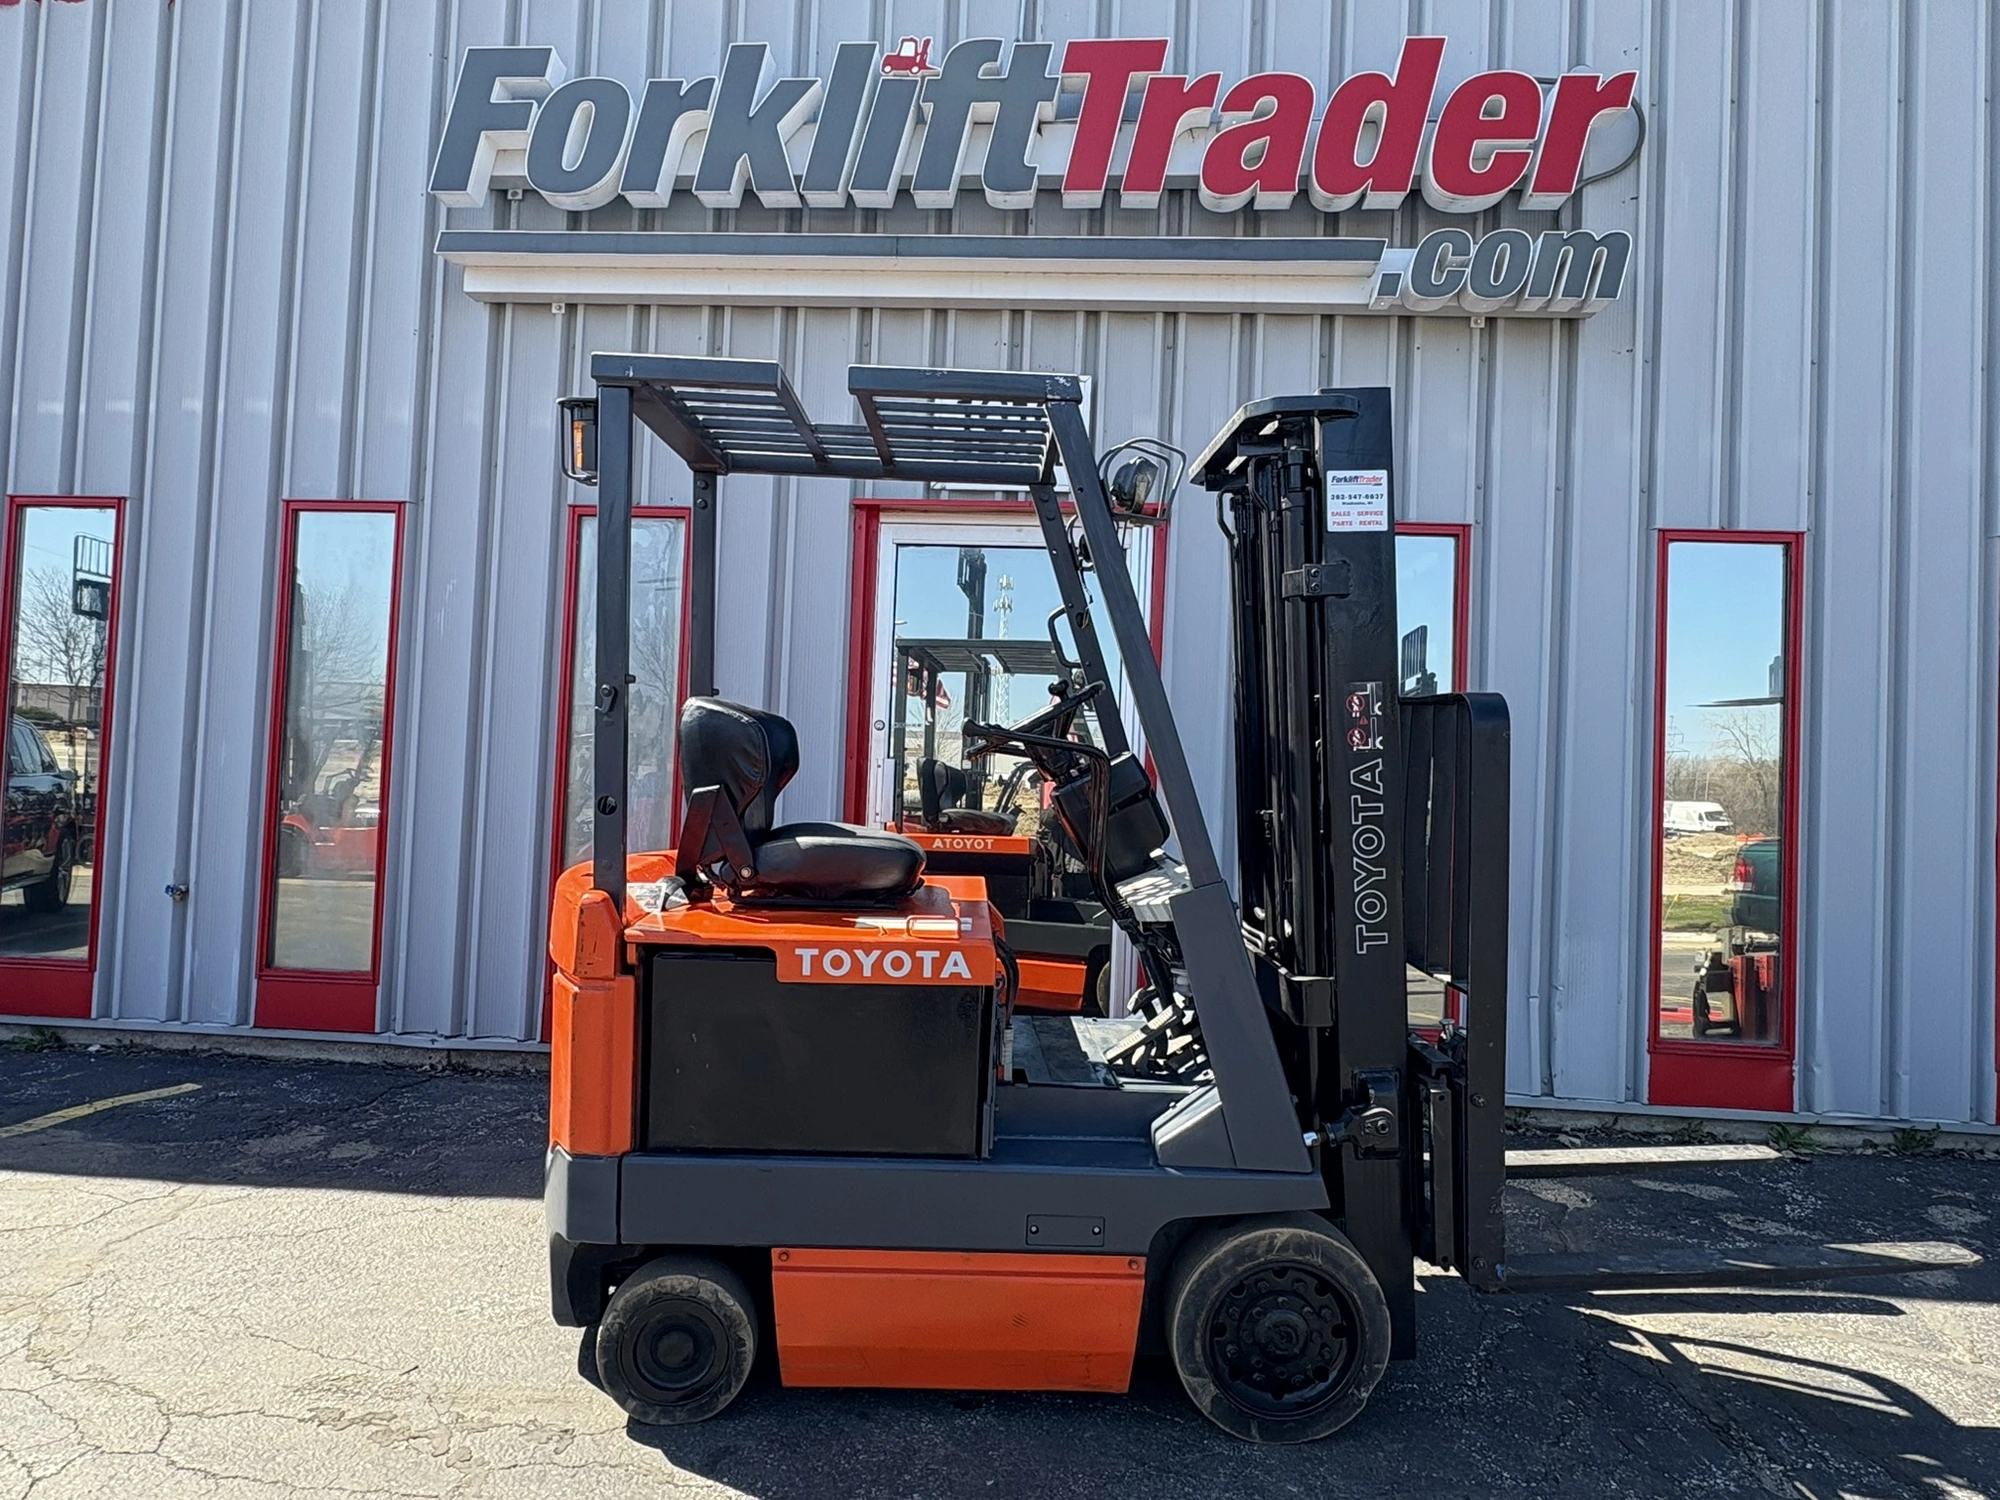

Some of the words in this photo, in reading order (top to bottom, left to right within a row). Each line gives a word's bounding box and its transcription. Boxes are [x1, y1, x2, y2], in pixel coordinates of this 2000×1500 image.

[429, 35, 1639, 198] ForkliftTrader
[1377, 228, 1632, 301] .com
[1350, 758, 1389, 955] TOYOTA
[795, 948, 972, 979] TOYOTA
